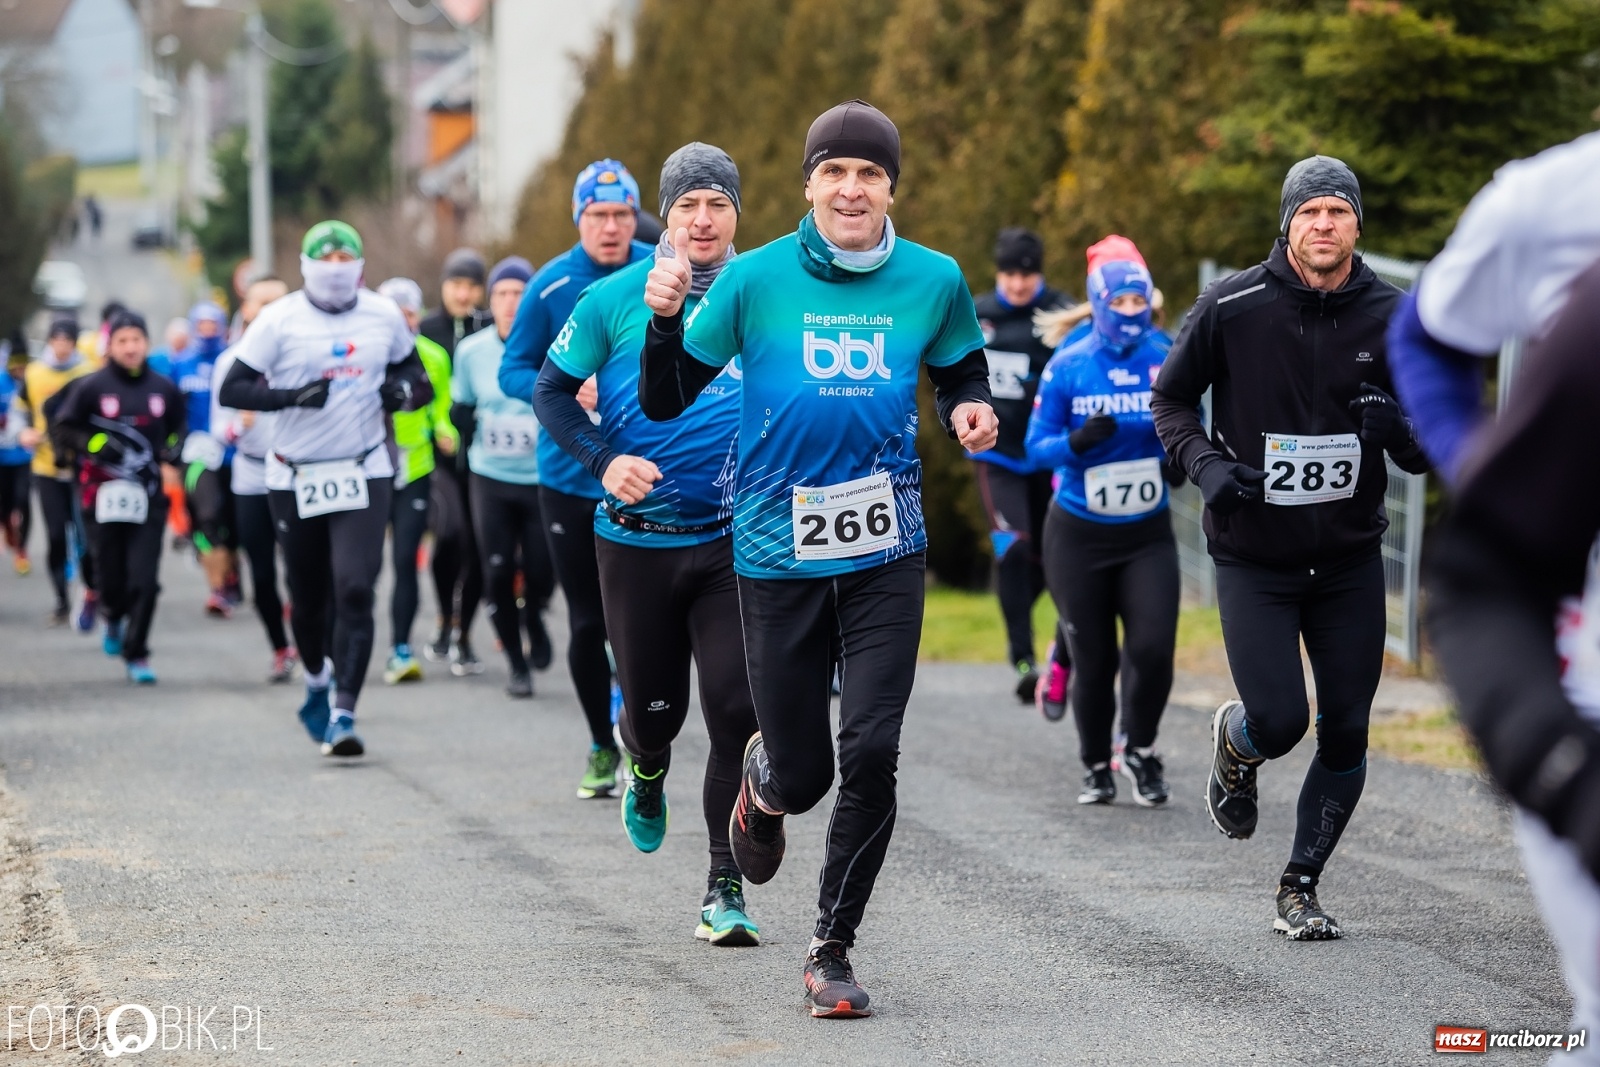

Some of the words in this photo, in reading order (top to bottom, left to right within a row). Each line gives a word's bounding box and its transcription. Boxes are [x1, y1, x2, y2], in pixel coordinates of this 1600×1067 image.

[803, 312, 893, 327] BiegamBoLubię
[803, 331, 891, 380] bbl
[819, 385, 875, 397] RACIBÓRZ
[1301, 442, 1358, 451] www.personalbest.pl
[1270, 460, 1354, 492] 283
[303, 477, 360, 505] 203
[829, 481, 889, 500] www.personalbest.pl
[1095, 480, 1157, 508] 170
[800, 502, 892, 546] 266
[1304, 795, 1345, 861] Kalenji
